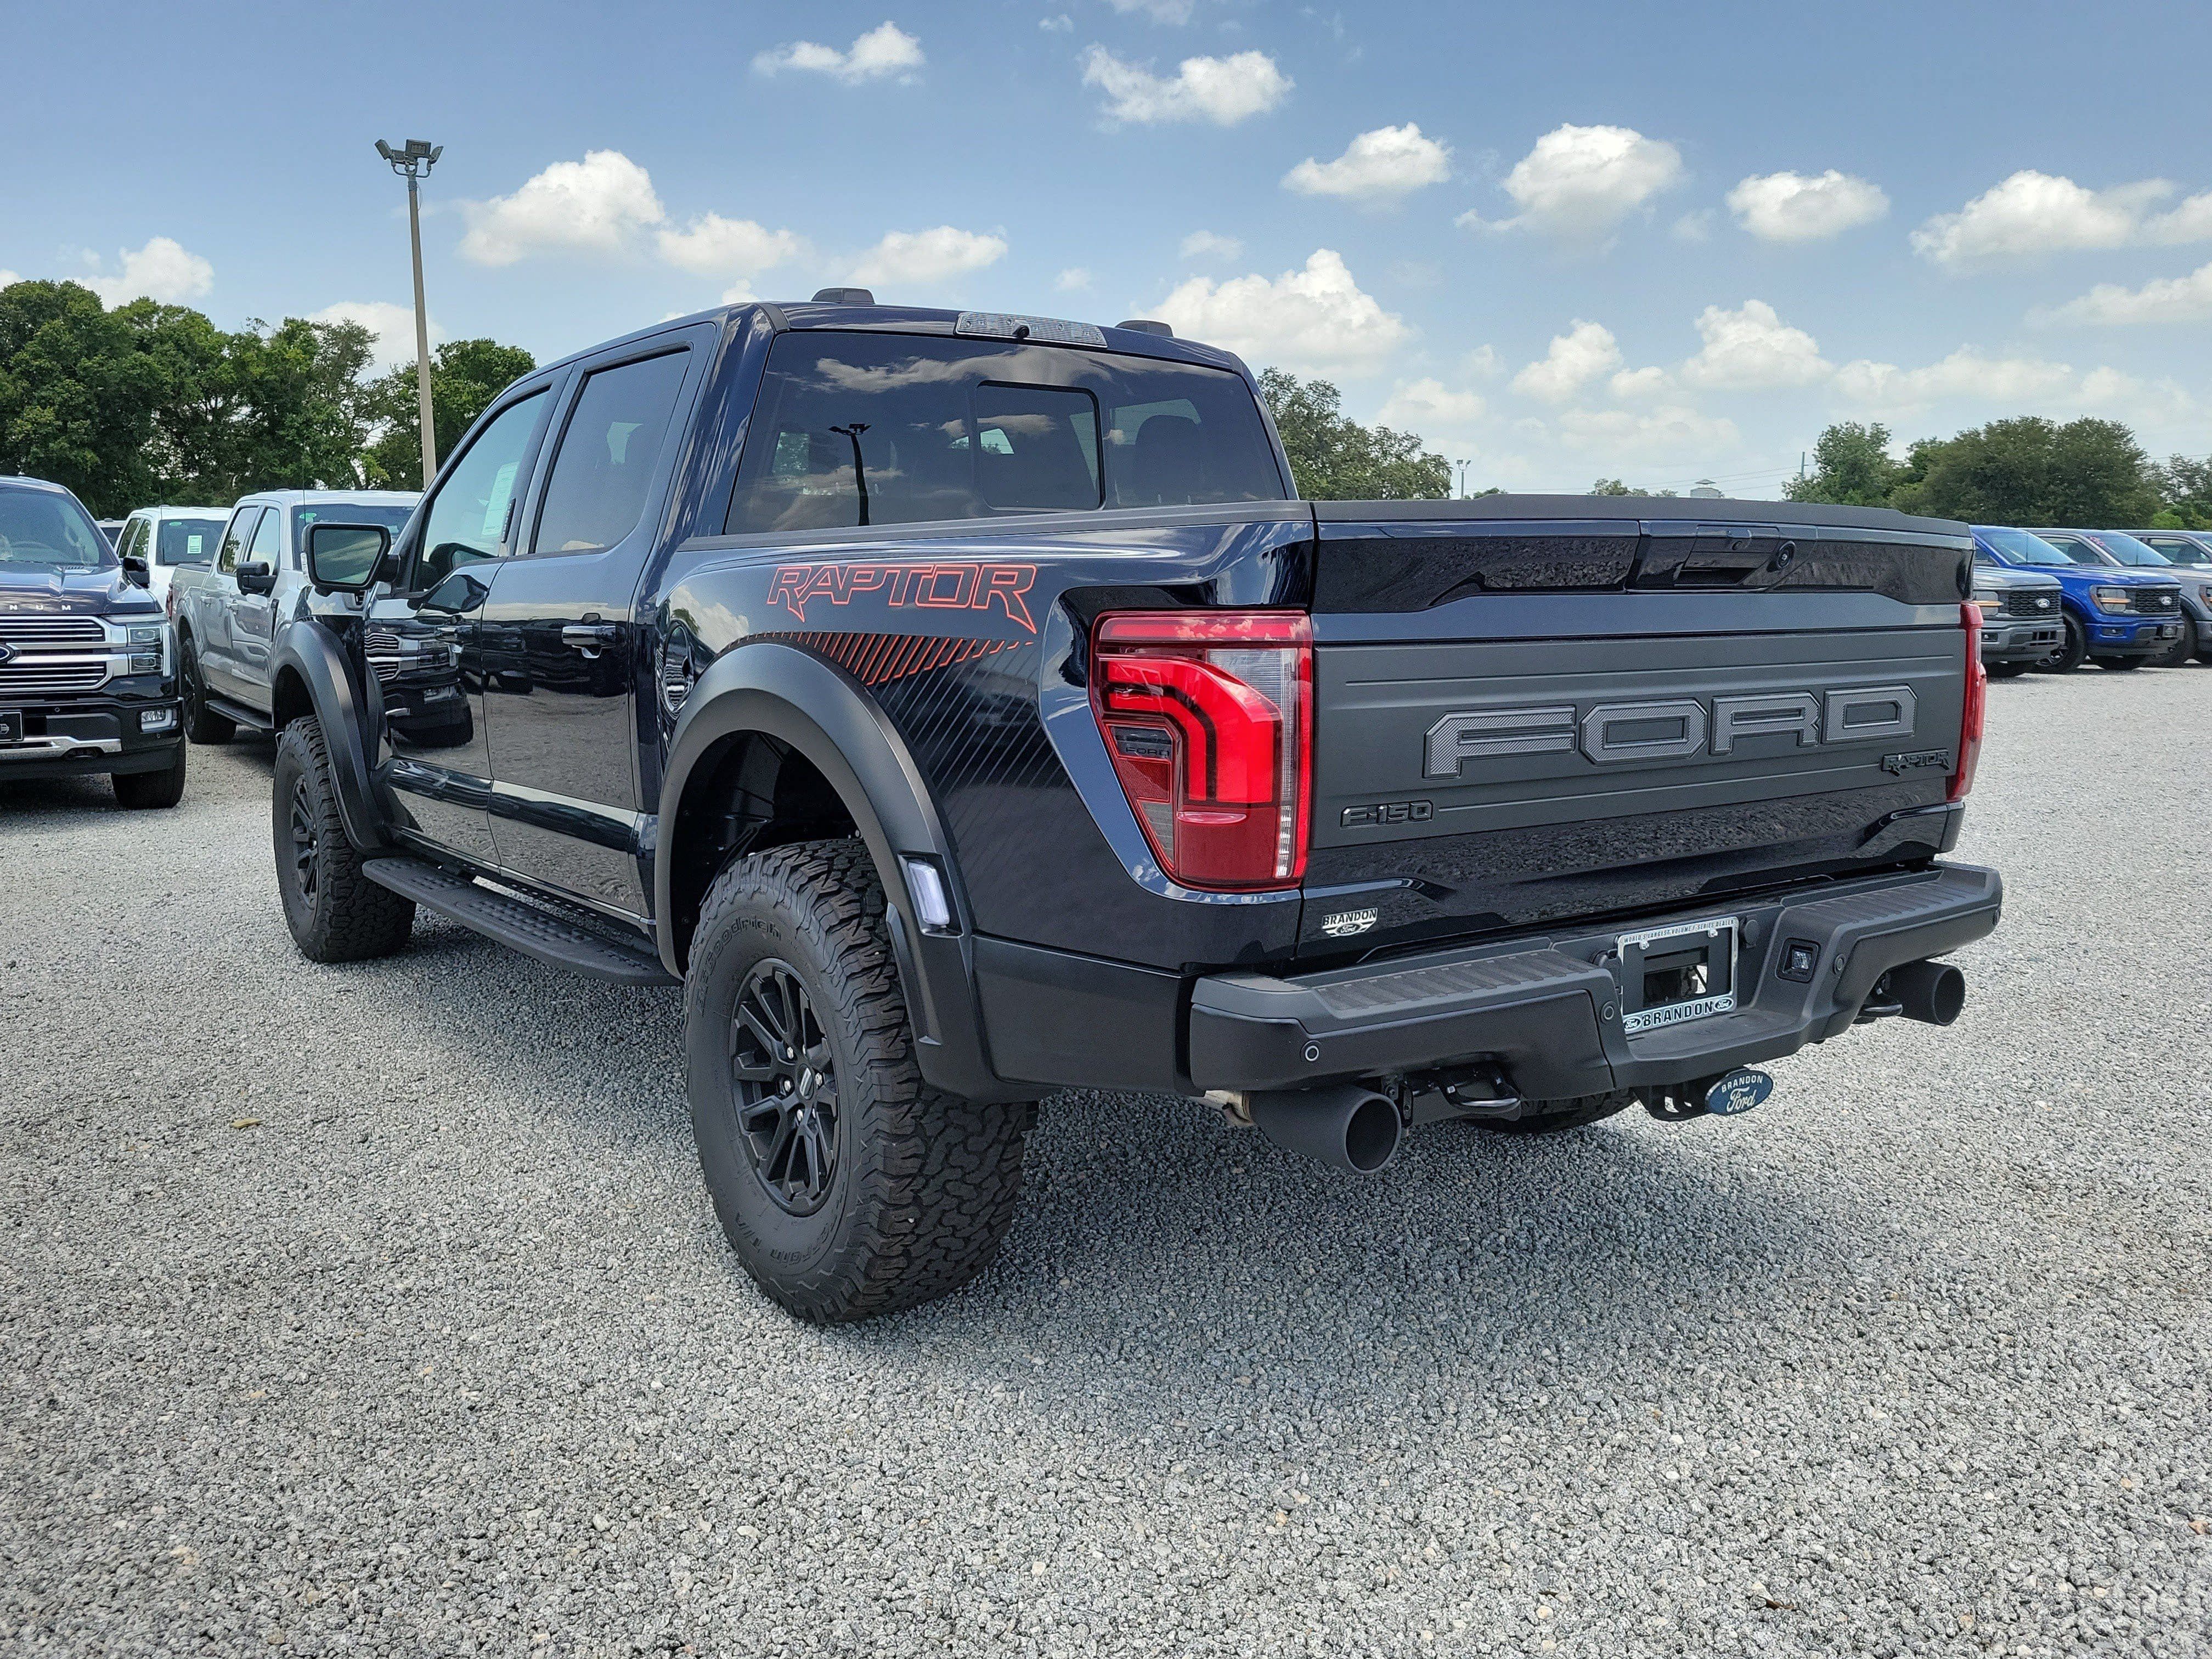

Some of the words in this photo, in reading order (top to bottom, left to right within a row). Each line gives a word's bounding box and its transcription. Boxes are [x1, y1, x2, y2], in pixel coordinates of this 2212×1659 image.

[768, 563, 1037, 634] RAPTOR
[1423, 685, 1918, 779] FORD
[1126, 747, 1170, 757] FORD
[1881, 748, 1950, 777] RAPTOR
[1340, 800, 1434, 827] F-150
[1322, 910, 1376, 926] BRANDON
[1642, 1001, 1713, 1027] BRANDON
[1722, 1075, 1763, 1093] BRANDON
[1726, 1086, 1757, 1112] Ford
